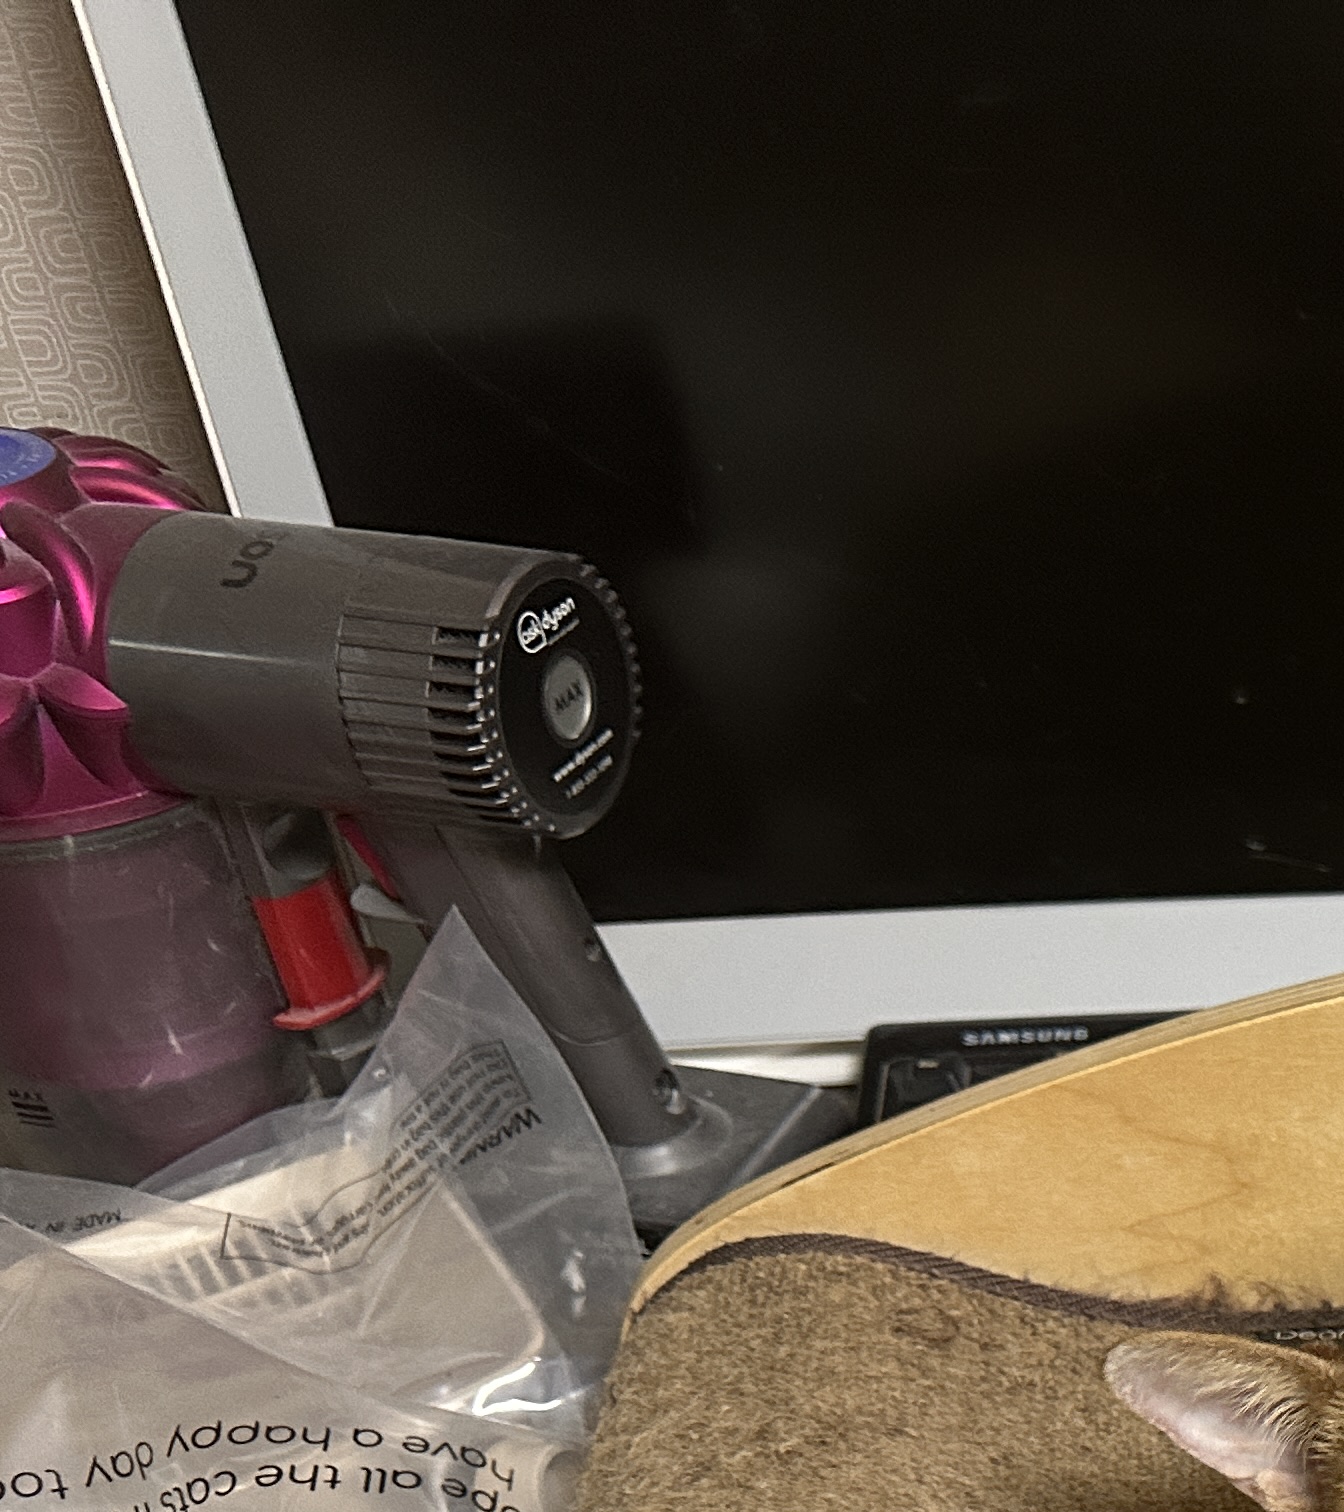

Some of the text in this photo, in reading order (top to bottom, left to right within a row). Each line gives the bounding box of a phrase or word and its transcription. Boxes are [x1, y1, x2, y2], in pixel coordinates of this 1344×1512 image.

[554, 678, 585, 713] MAX
[960, 1024, 1090, 1048] SAMSUNG
[0, 1420, 515, 1500] have a happy day to
[254, 1464, 342, 1492] the
[360, 1466, 423, 1494] all
